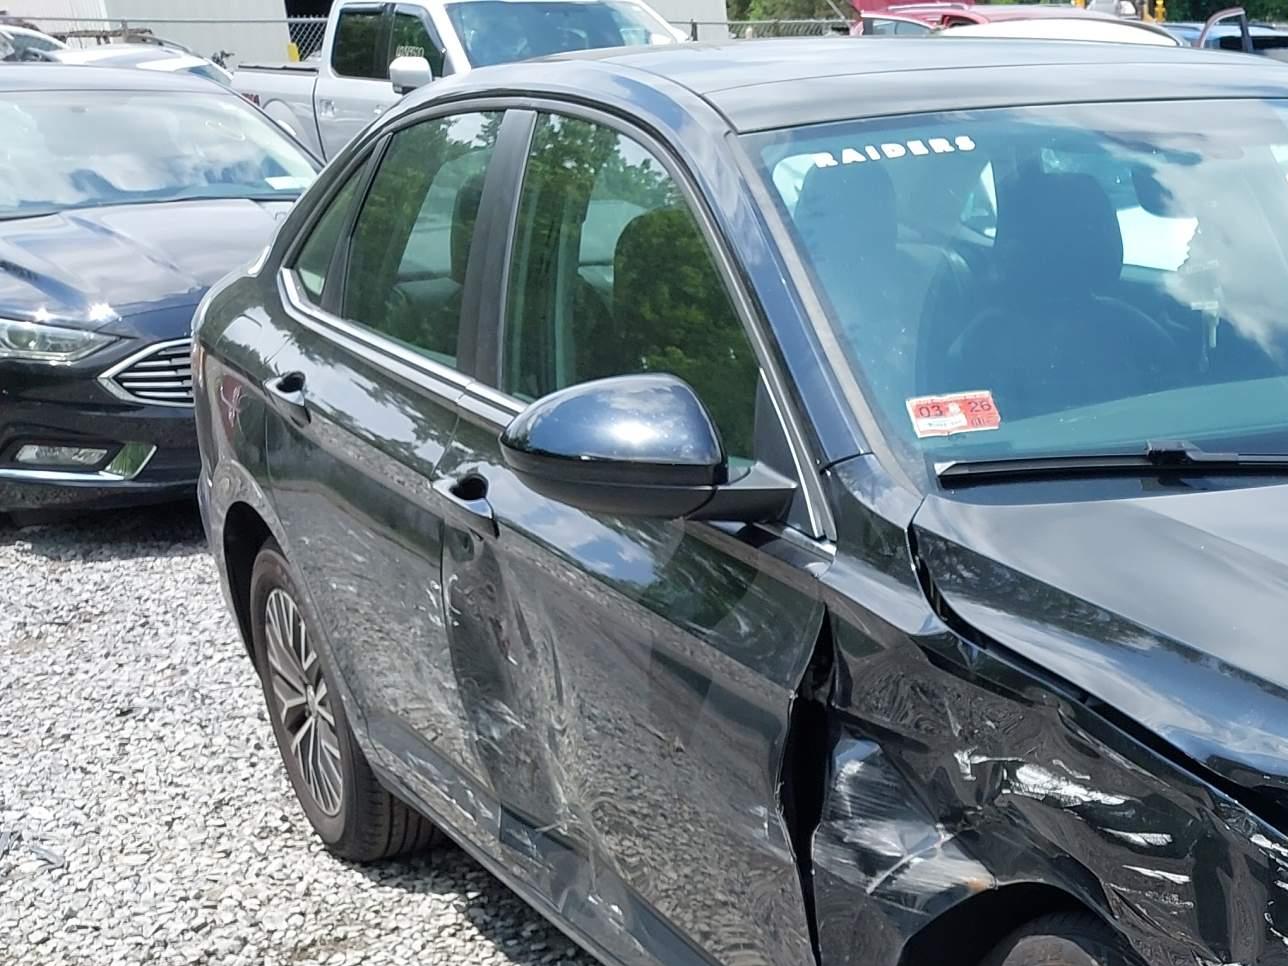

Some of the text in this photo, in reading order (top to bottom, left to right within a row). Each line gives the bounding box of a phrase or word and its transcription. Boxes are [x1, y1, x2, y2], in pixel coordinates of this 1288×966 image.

[815, 135, 976, 169] RAIDERS
[918, 400, 992, 418] 03 26
